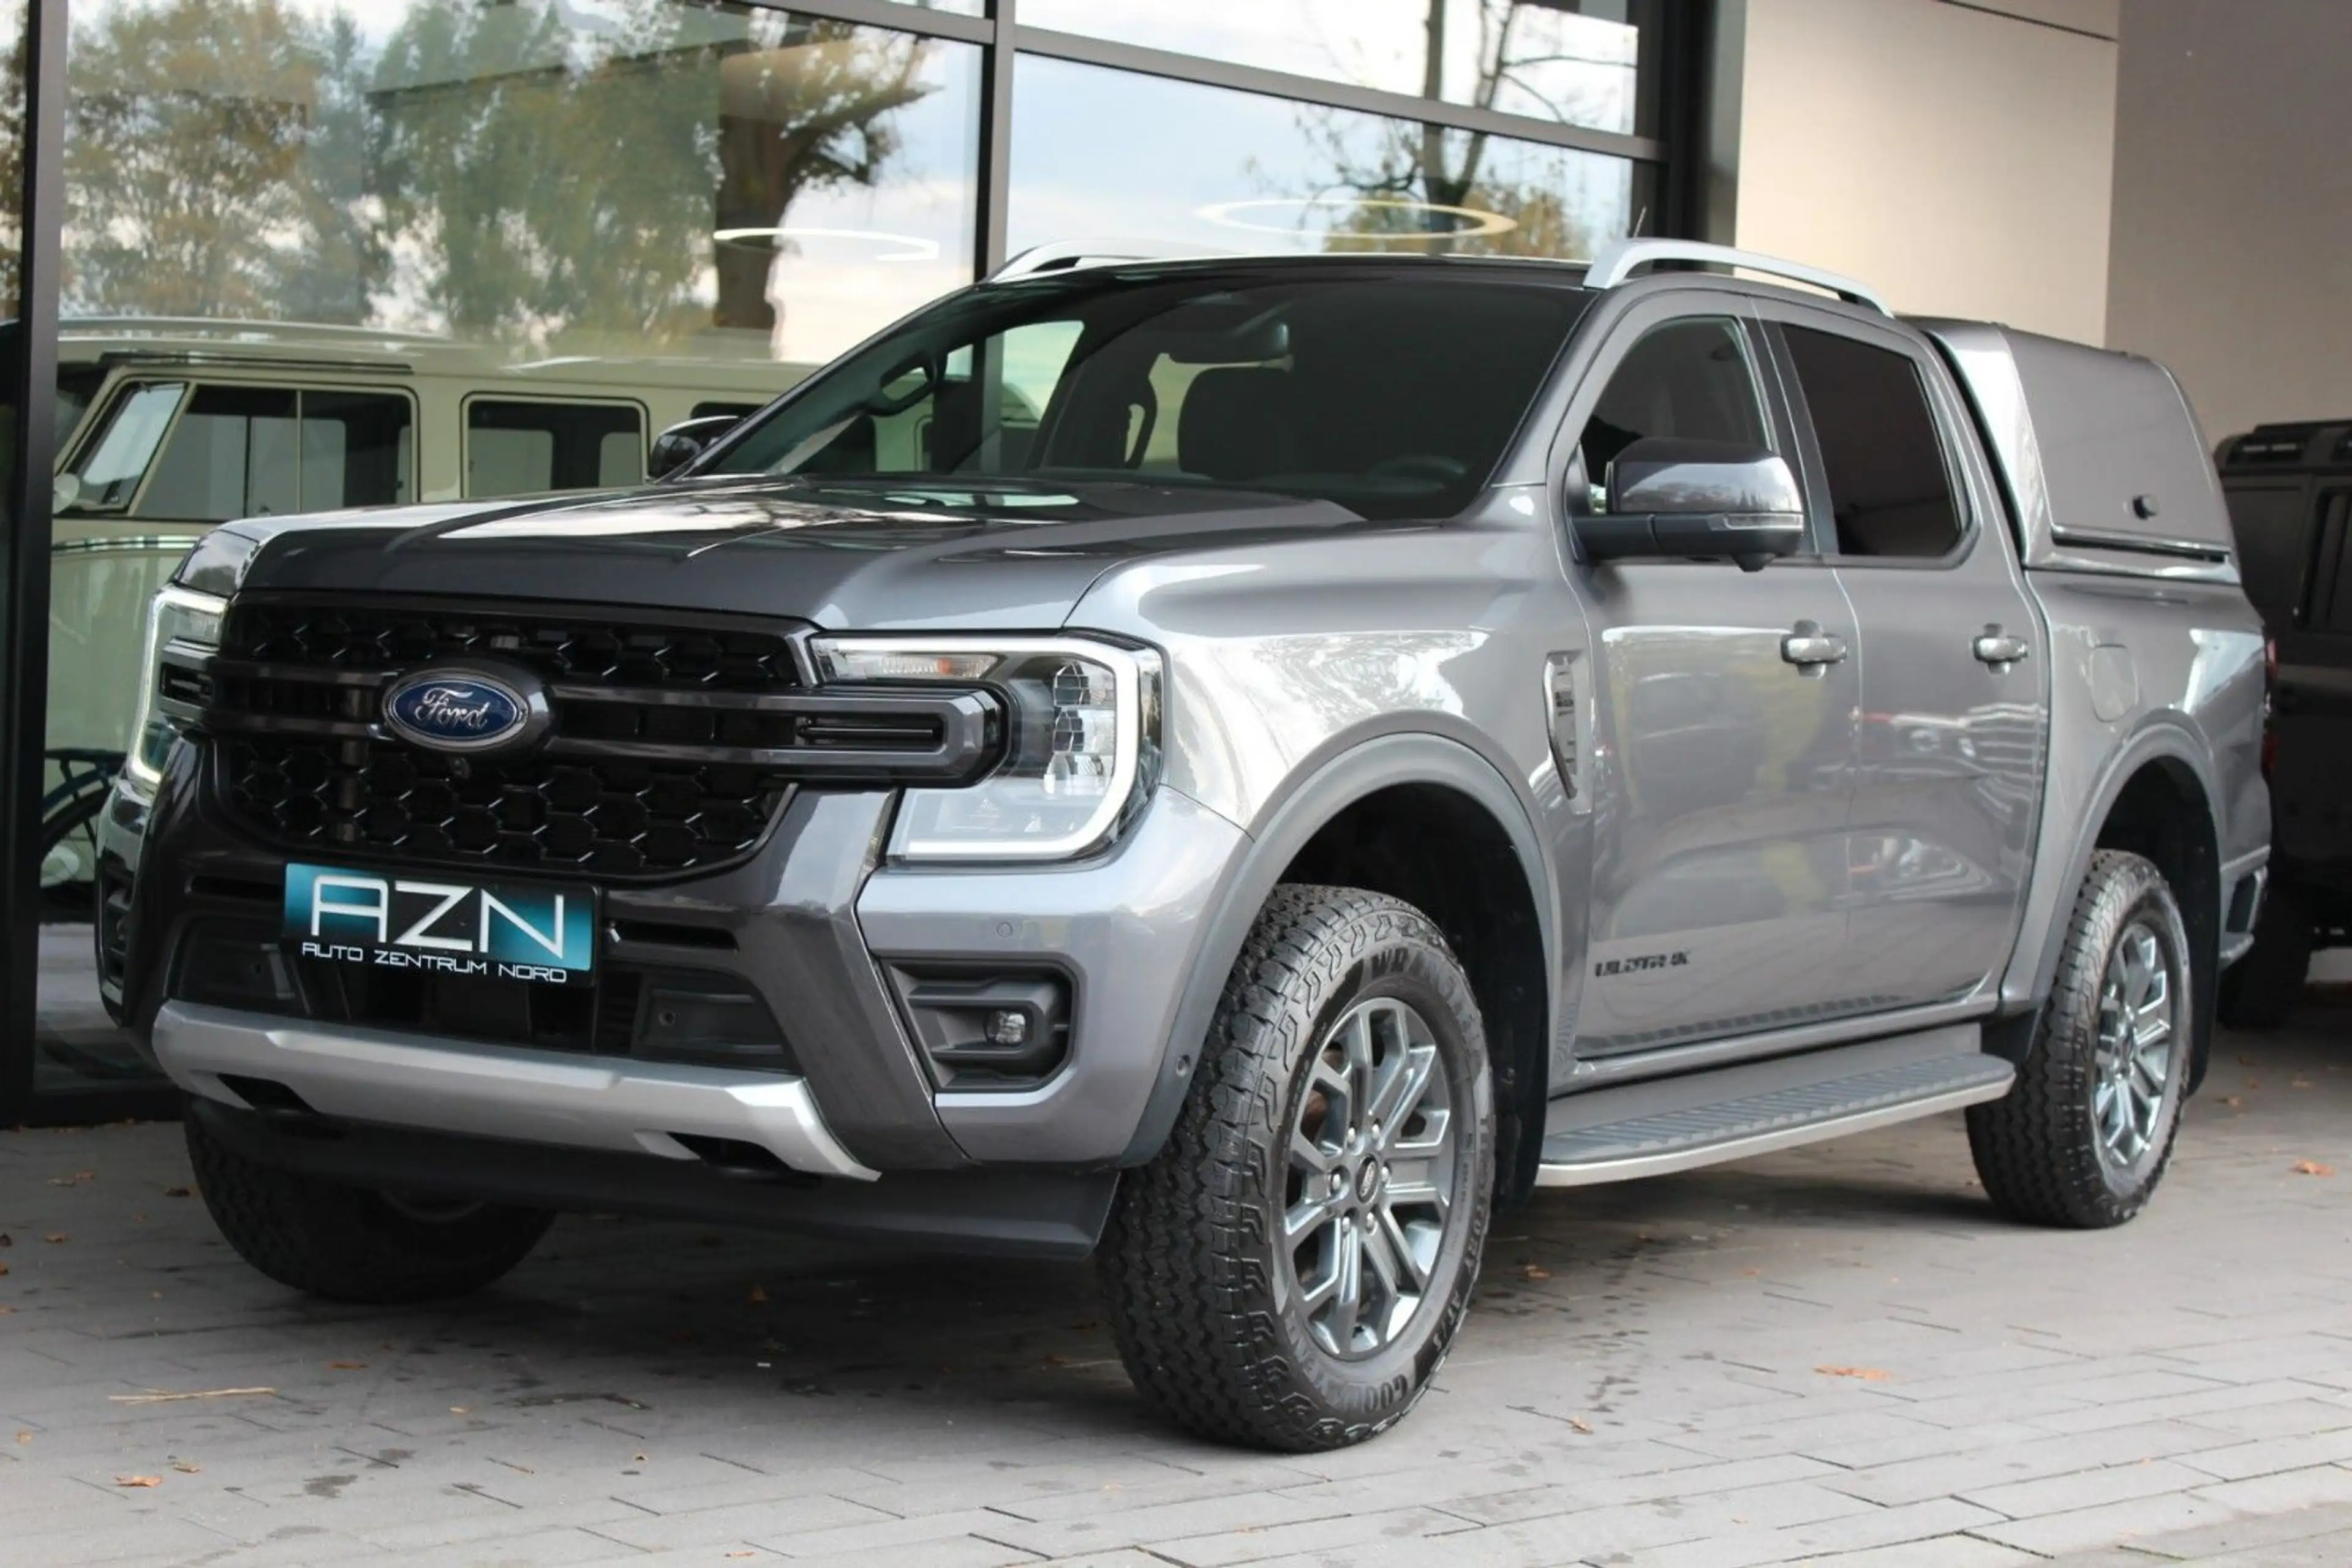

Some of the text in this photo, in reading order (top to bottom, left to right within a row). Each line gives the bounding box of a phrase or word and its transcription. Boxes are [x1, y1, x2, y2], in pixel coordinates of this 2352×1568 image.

[414, 687, 491, 730] Ford
[310, 874, 564, 960] AZN
[301, 941, 567, 984] AUTO ZENTRUM NORD
